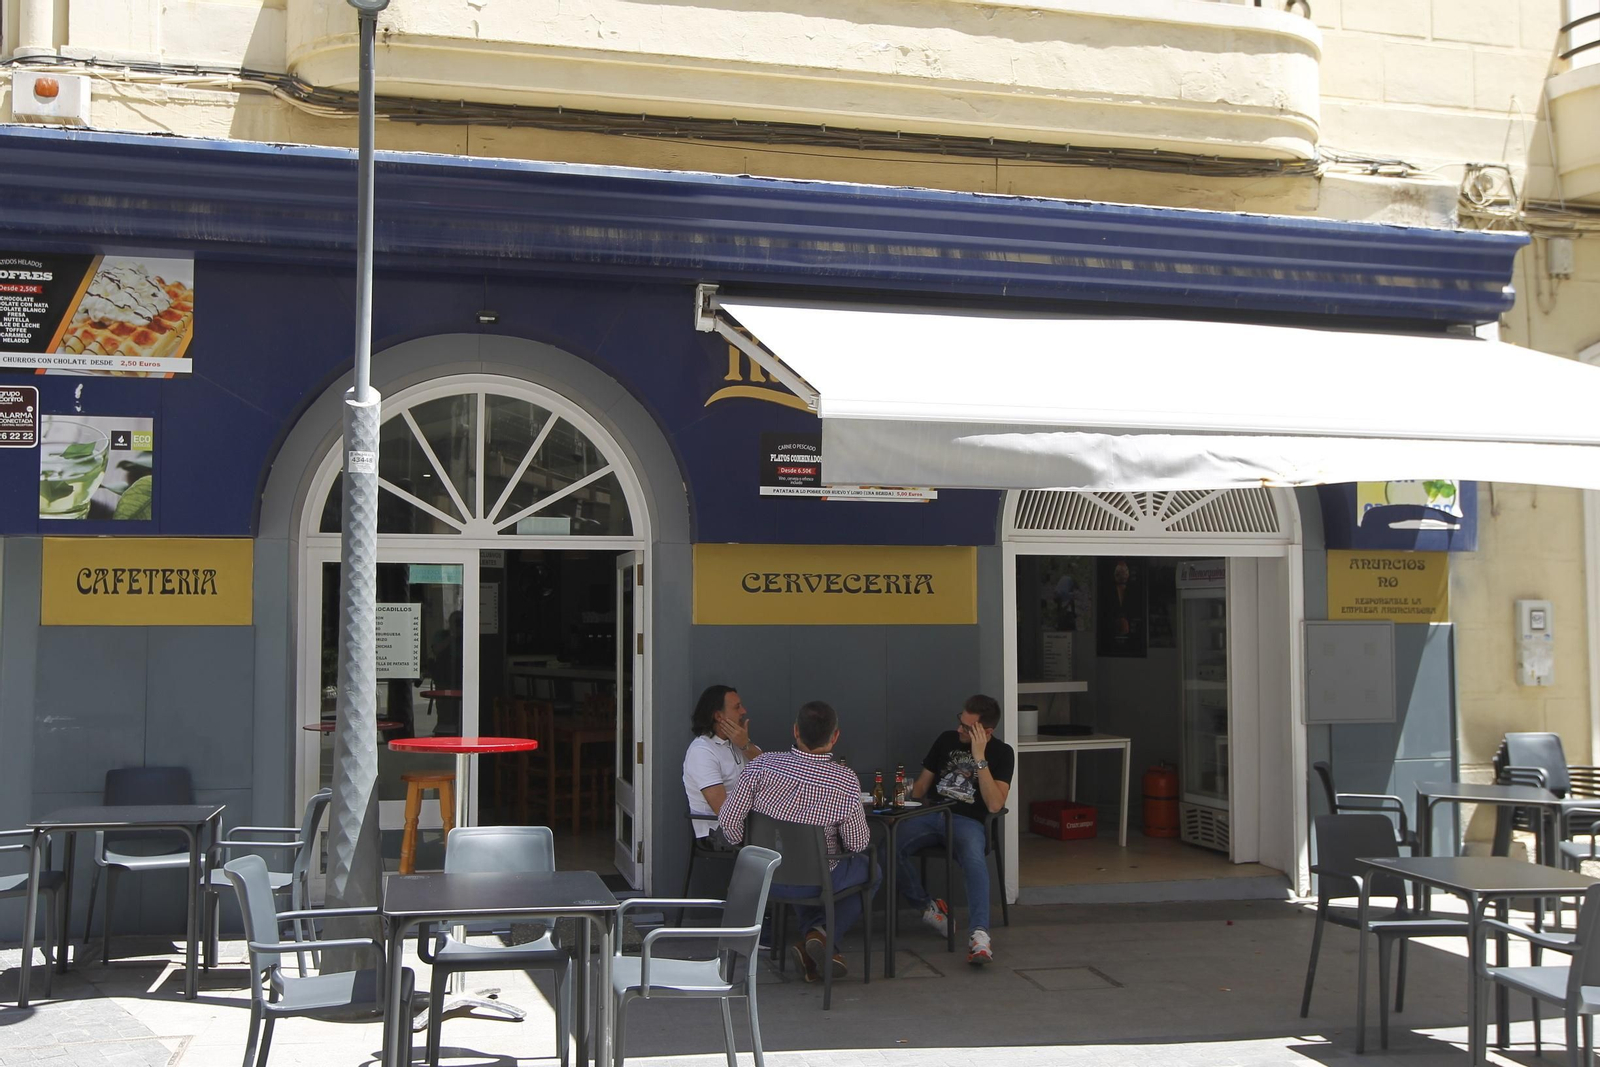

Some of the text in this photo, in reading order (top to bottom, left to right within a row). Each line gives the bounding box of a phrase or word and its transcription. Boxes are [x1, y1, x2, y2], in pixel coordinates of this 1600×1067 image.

[18, 259, 43, 268] HELADOS
[0, 270, 53, 281] OFRES
[133, 435, 151, 443] ECO
[770, 454, 790, 462] PLATOS
[1349, 558, 1426, 571] ANUNCIOS
[76, 567, 218, 595] CAFETERIA
[741, 573, 935, 595] CERVECERIA
[1377, 576, 1399, 588] NO
[1341, 606, 1437, 614] EMPRESA ANUNCIADORA
[1066, 820, 1093, 830] Cruzcampo
